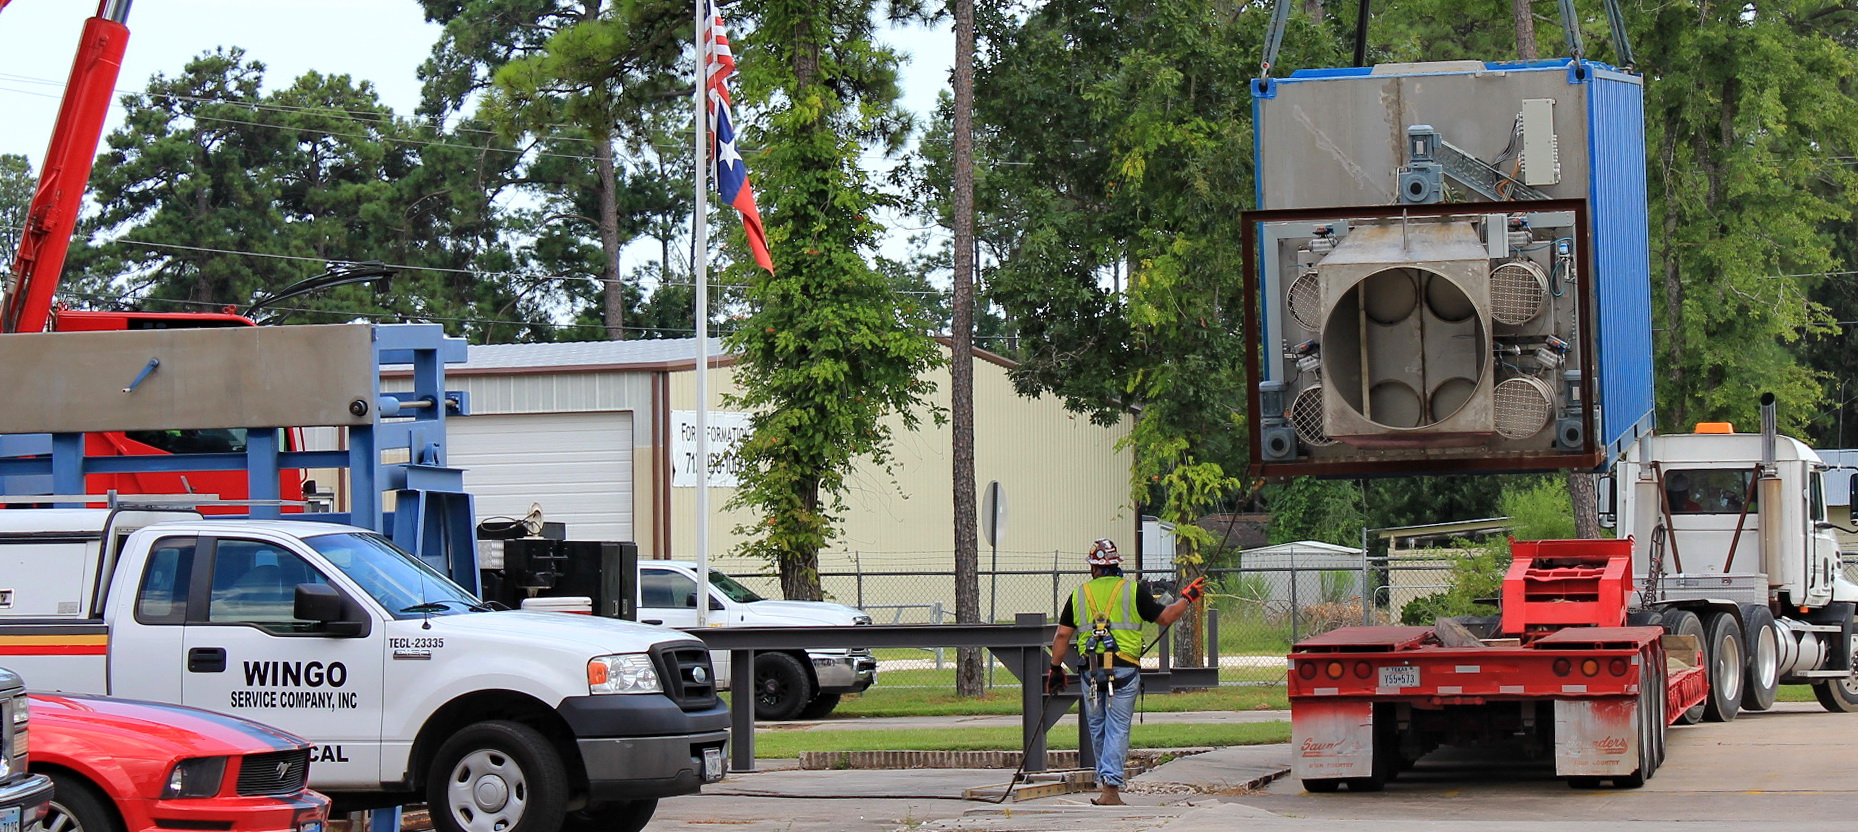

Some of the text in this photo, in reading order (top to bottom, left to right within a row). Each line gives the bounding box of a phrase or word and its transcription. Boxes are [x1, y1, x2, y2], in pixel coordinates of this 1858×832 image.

[706, 426, 750, 443] FORMATION
[389, 637, 444, 649] TECL-23335
[243, 660, 347, 688] WINGO
[230, 690, 357, 712] SERVICE COMPANY, INC
